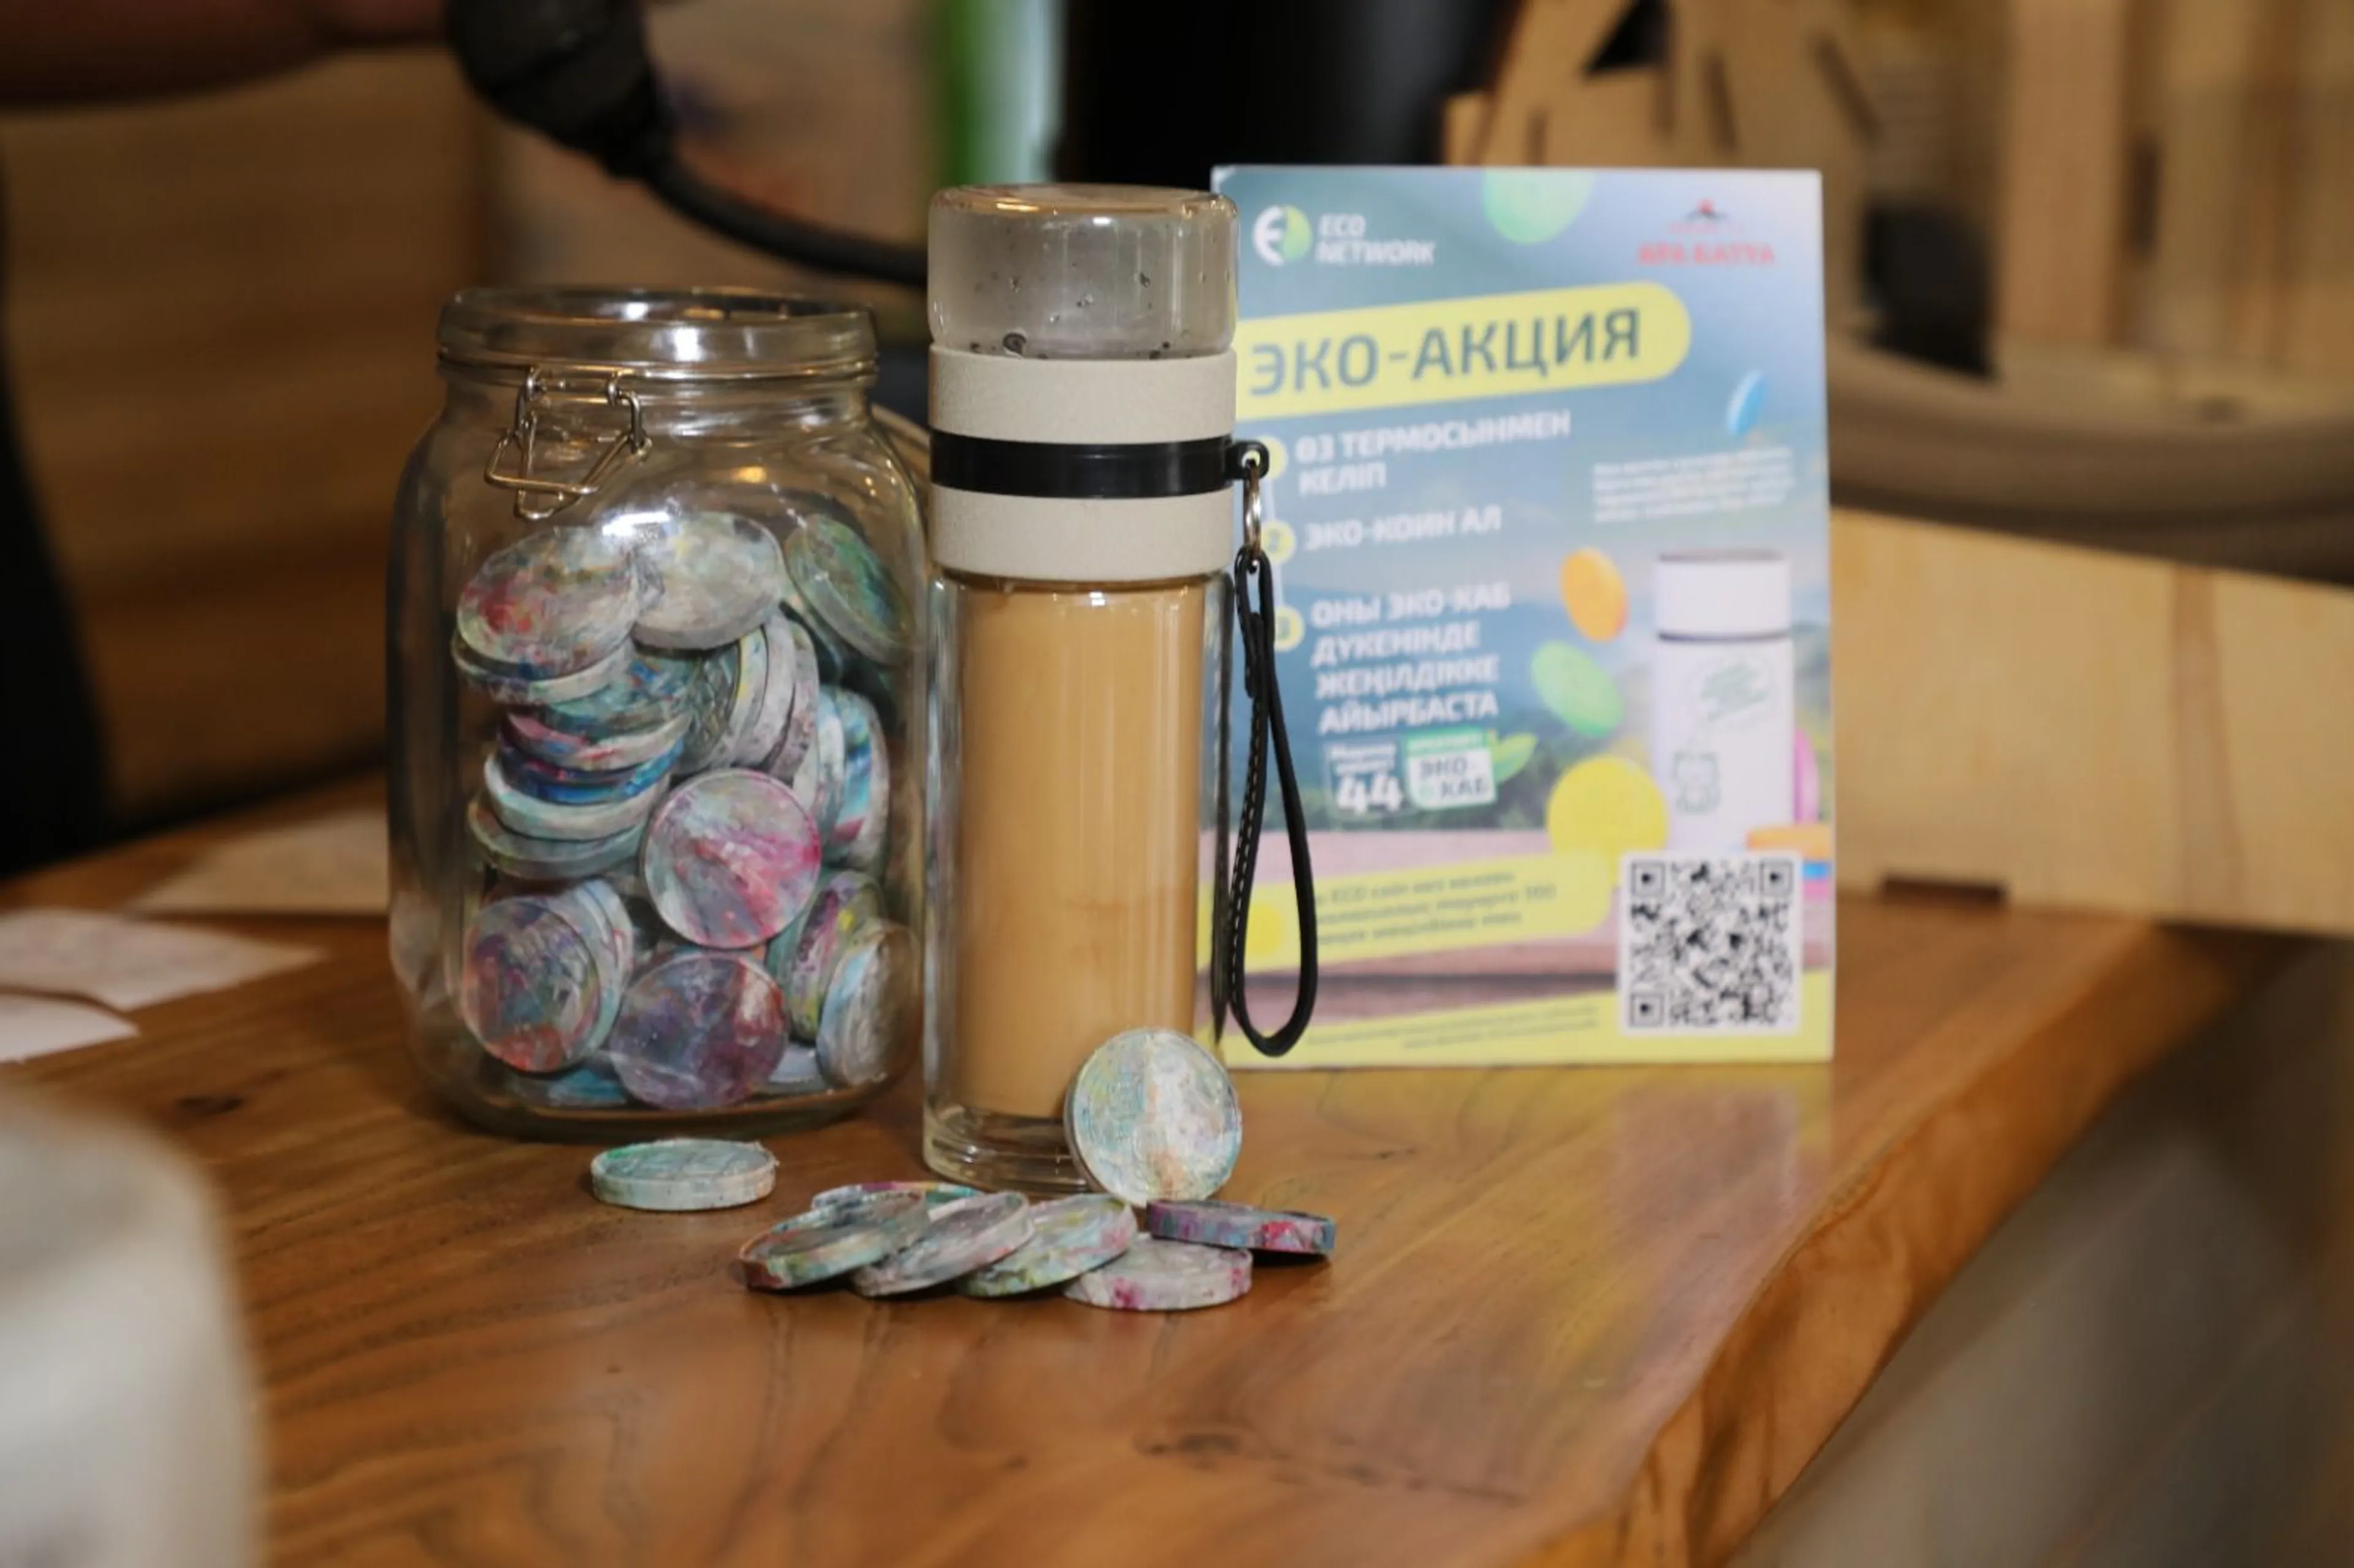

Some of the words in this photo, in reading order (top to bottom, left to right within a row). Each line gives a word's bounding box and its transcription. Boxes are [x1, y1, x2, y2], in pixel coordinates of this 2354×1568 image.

[1319, 213, 1366, 237] ECO
[1316, 240, 1435, 266] NETWORK
[1251, 308, 1639, 395] ЭКО-АКЦИЯ
